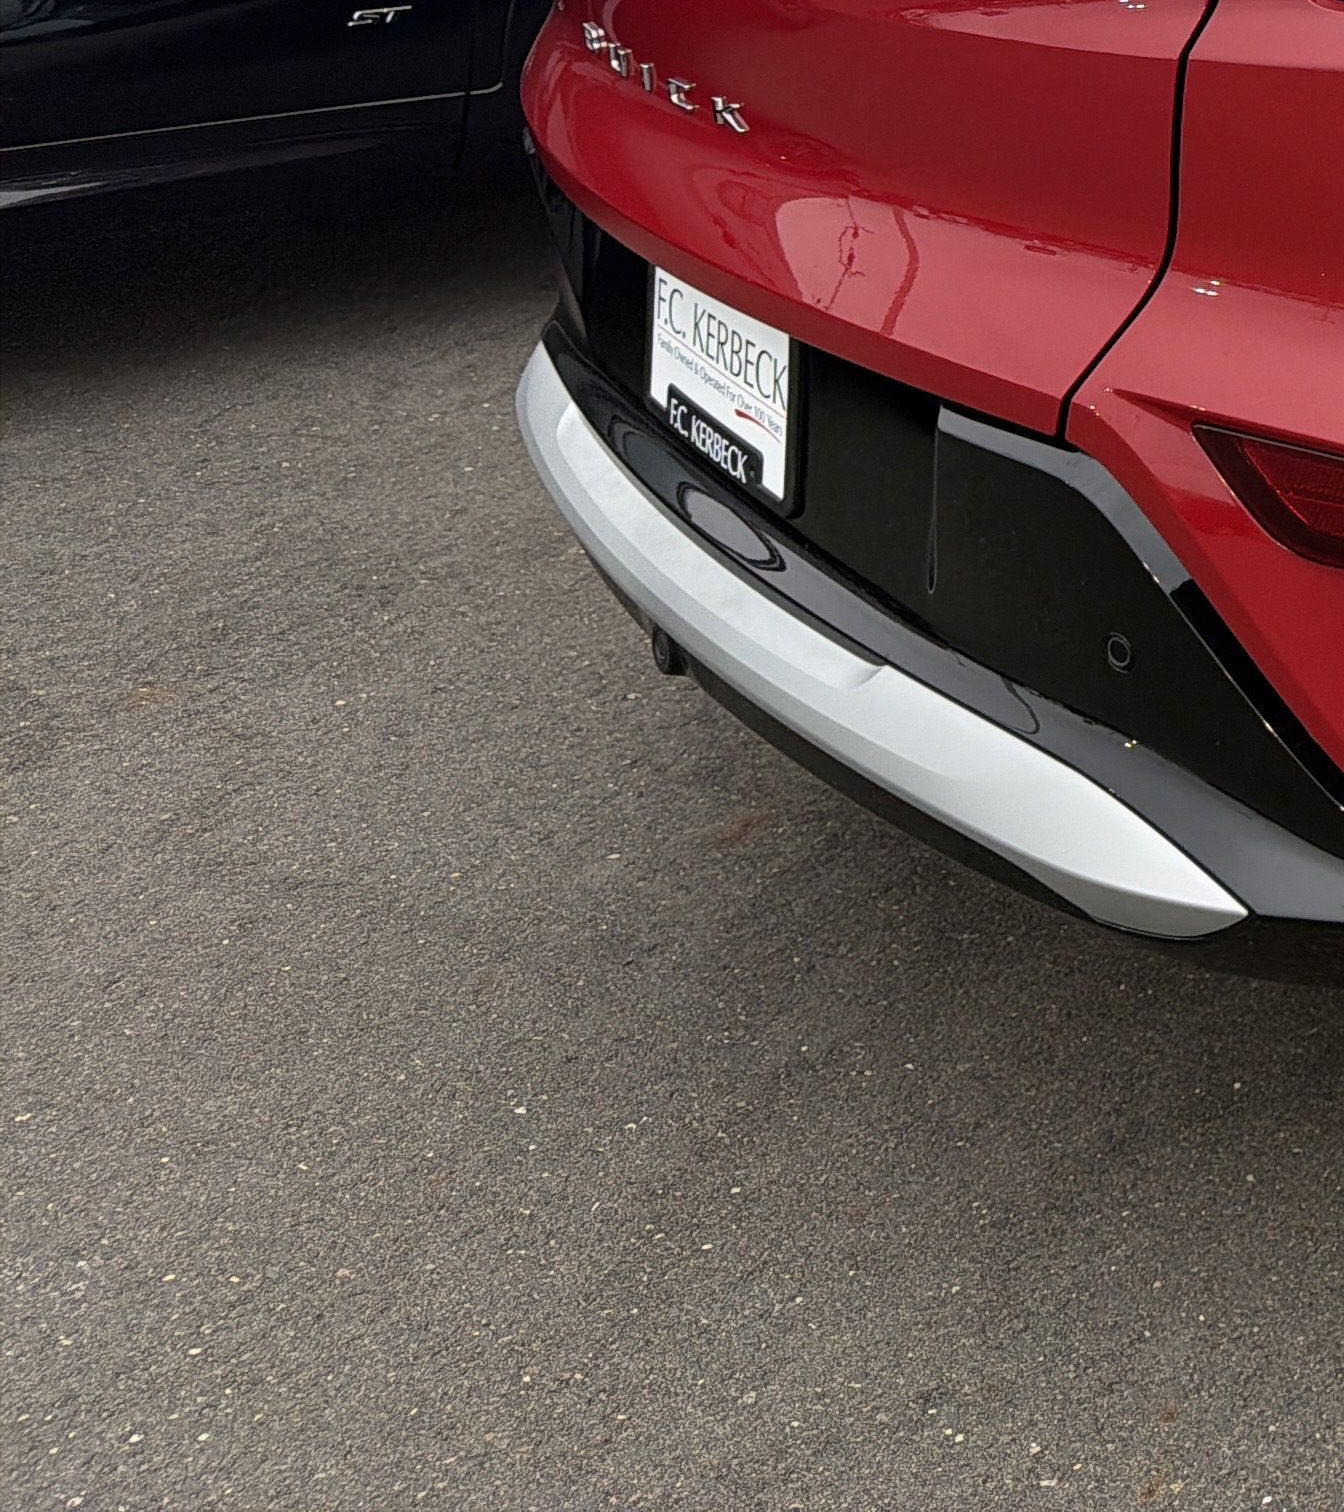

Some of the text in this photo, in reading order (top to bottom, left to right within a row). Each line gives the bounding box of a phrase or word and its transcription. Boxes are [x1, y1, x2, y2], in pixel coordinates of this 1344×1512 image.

[582, 20, 751, 134] BUICK
[656, 276, 788, 412] F.C. KERBECK
[669, 397, 749, 485] F.C. KERBECK
[700, 365, 726, 396] Operated
[737, 393, 753, 414] Over
[754, 405, 766, 424] 100
[766, 414, 784, 437] Years
